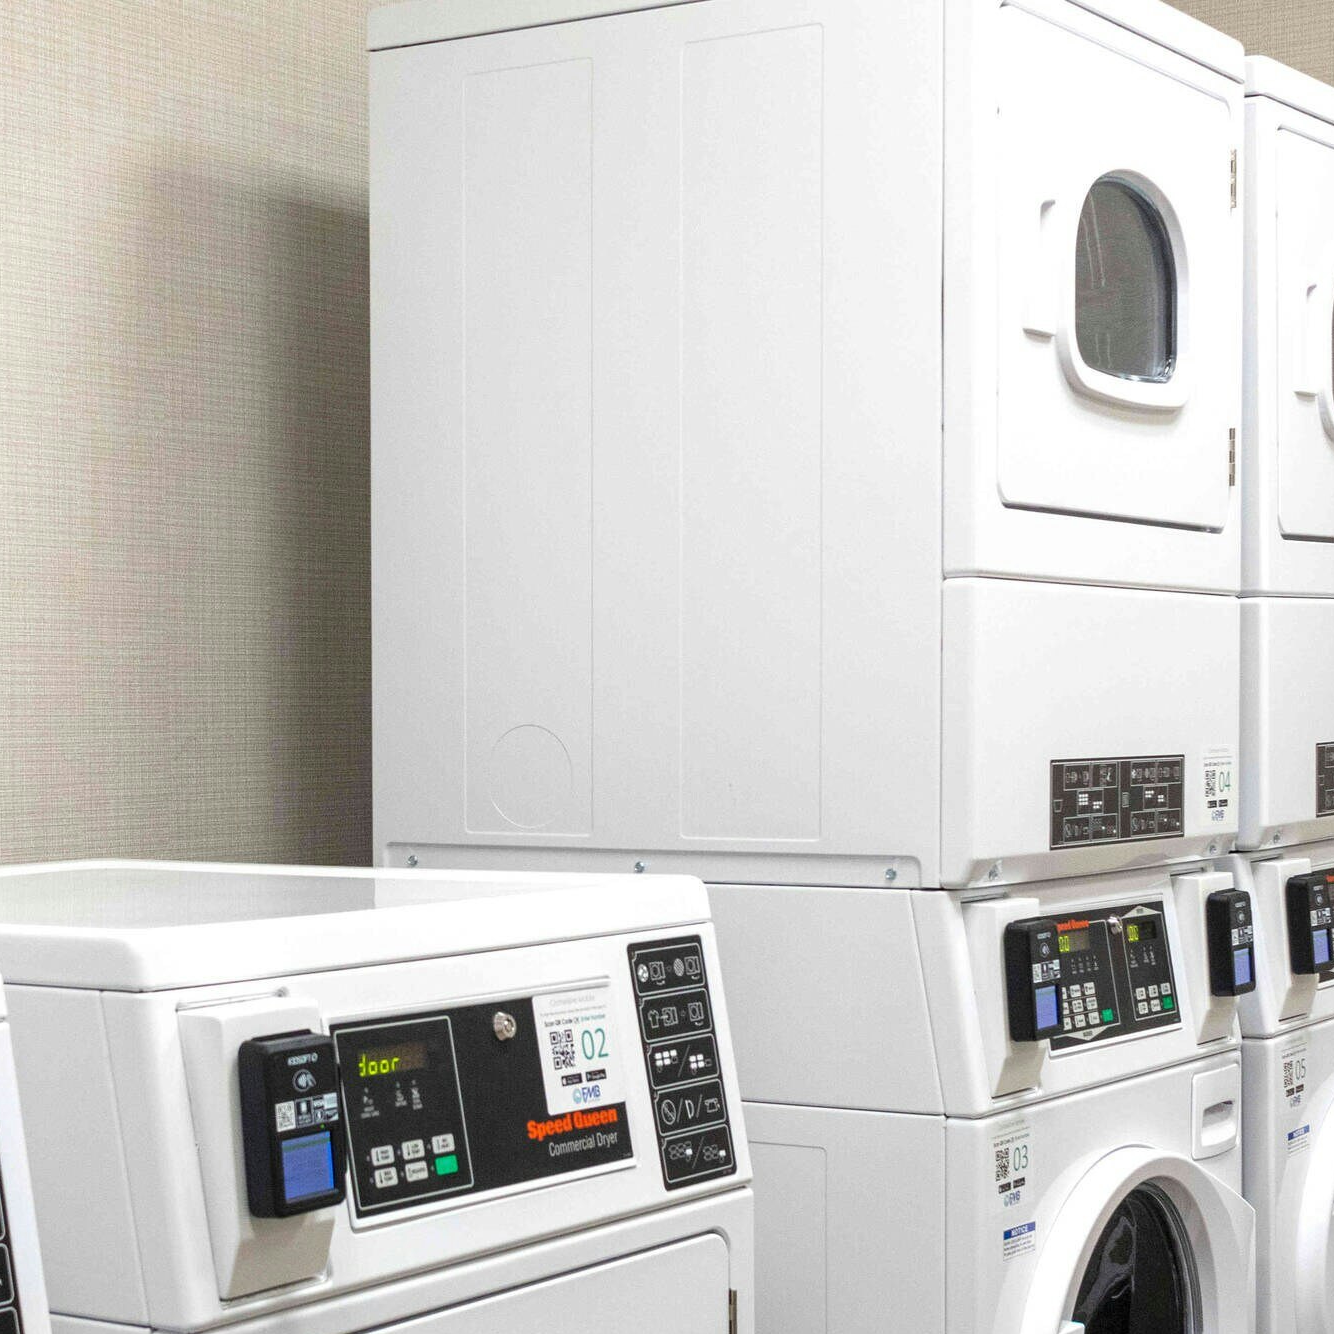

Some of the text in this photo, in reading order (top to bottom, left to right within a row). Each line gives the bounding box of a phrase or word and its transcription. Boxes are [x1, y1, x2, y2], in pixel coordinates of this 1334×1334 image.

[581, 1028, 609, 1060] 02
[527, 1108, 617, 1142] Speed Queen
[549, 1131, 617, 1158] Commercial Dryer
[1013, 1144, 1029, 1172] 03
